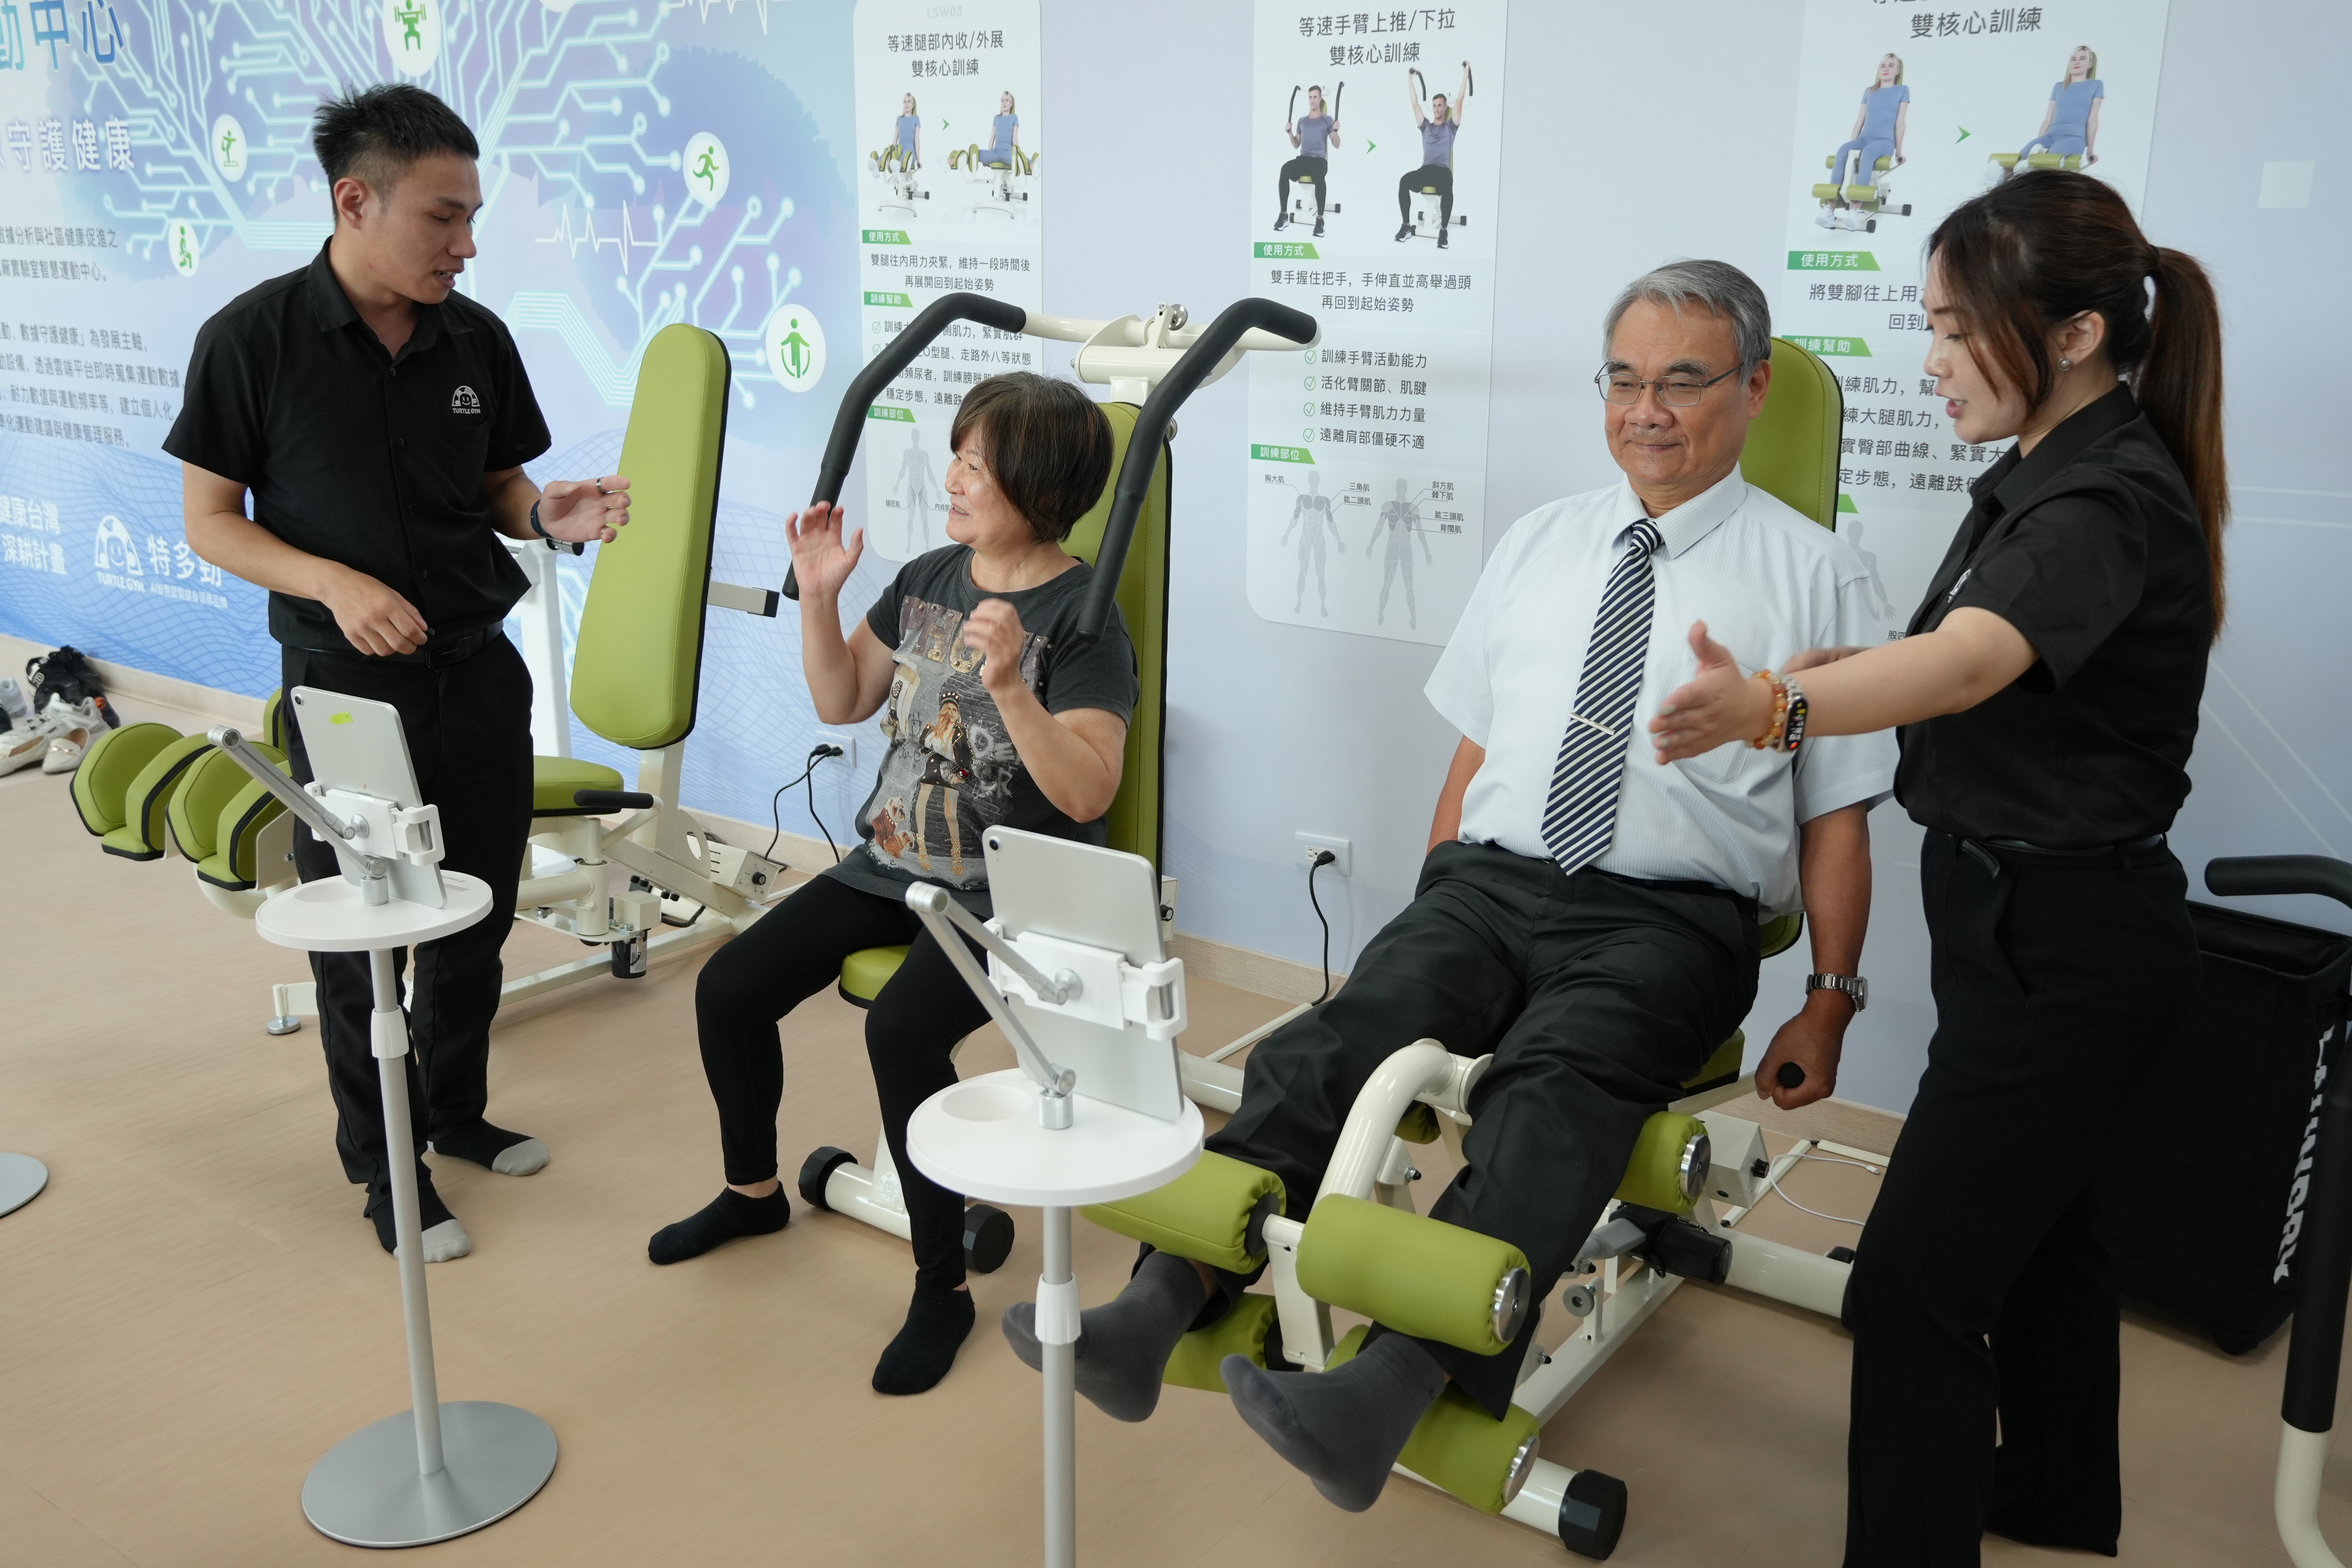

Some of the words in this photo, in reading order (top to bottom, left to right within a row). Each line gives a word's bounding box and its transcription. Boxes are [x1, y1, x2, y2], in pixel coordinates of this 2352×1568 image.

[927, 6, 963, 18] LSW03
[1299, 8, 1456, 37] 等速手臂上推/下拉
[1910, 7, 2042, 39] 雙核心訓練
[888, 30, 1004, 52] 等速腿部內收/外展
[1329, 42, 1420, 66] 雙核心訓練
[912, 58, 979, 77] 雙核心訓練
[0, 117, 135, 171] 守護健康
[869, 232, 899, 242] 使用方式
[1263, 244, 1304, 256] 使用方式
[1801, 253, 1858, 267] 使用方式
[0, 258, 107, 282] 廠實驗室智慧運動中心。
[905, 275, 994, 291] 再展開回到起始姿勢
[871, 294, 901, 305] 訓練幫助
[1809, 283, 1925, 302] 將雙腳往上用
[1321, 295, 1414, 313] 再回到起始姿勢
[1322, 349, 1427, 368] 訓練手臂活動能力
[1321, 375, 1427, 395] 活化臂關節、肌腱
[874, 407, 904, 420] 訓練部位
[1320, 401, 1426, 423] 維持手臂肌力力量
[1320, 428, 1425, 449] 遠離肩部僵硬不適
[1260, 447, 1300, 460] 訓練部位
[1265, 474, 1284, 484] 胸大肌
[1349, 482, 1370, 492] 三角肌
[1432, 481, 1454, 491] 斜方肌
[1344, 495, 1371, 506] 肱二頭肌
[1431, 491, 1453, 501] 棘下肌
[0, 493, 60, 534] 健康台灣
[1434, 511, 1464, 522] 肱三頭肌
[1440, 523, 1462, 534] 背闊肌
[1, 533, 68, 575] 深耕計畫
[98, 571, 126, 590] TURTLE
[126, 577, 145, 593] GYM
